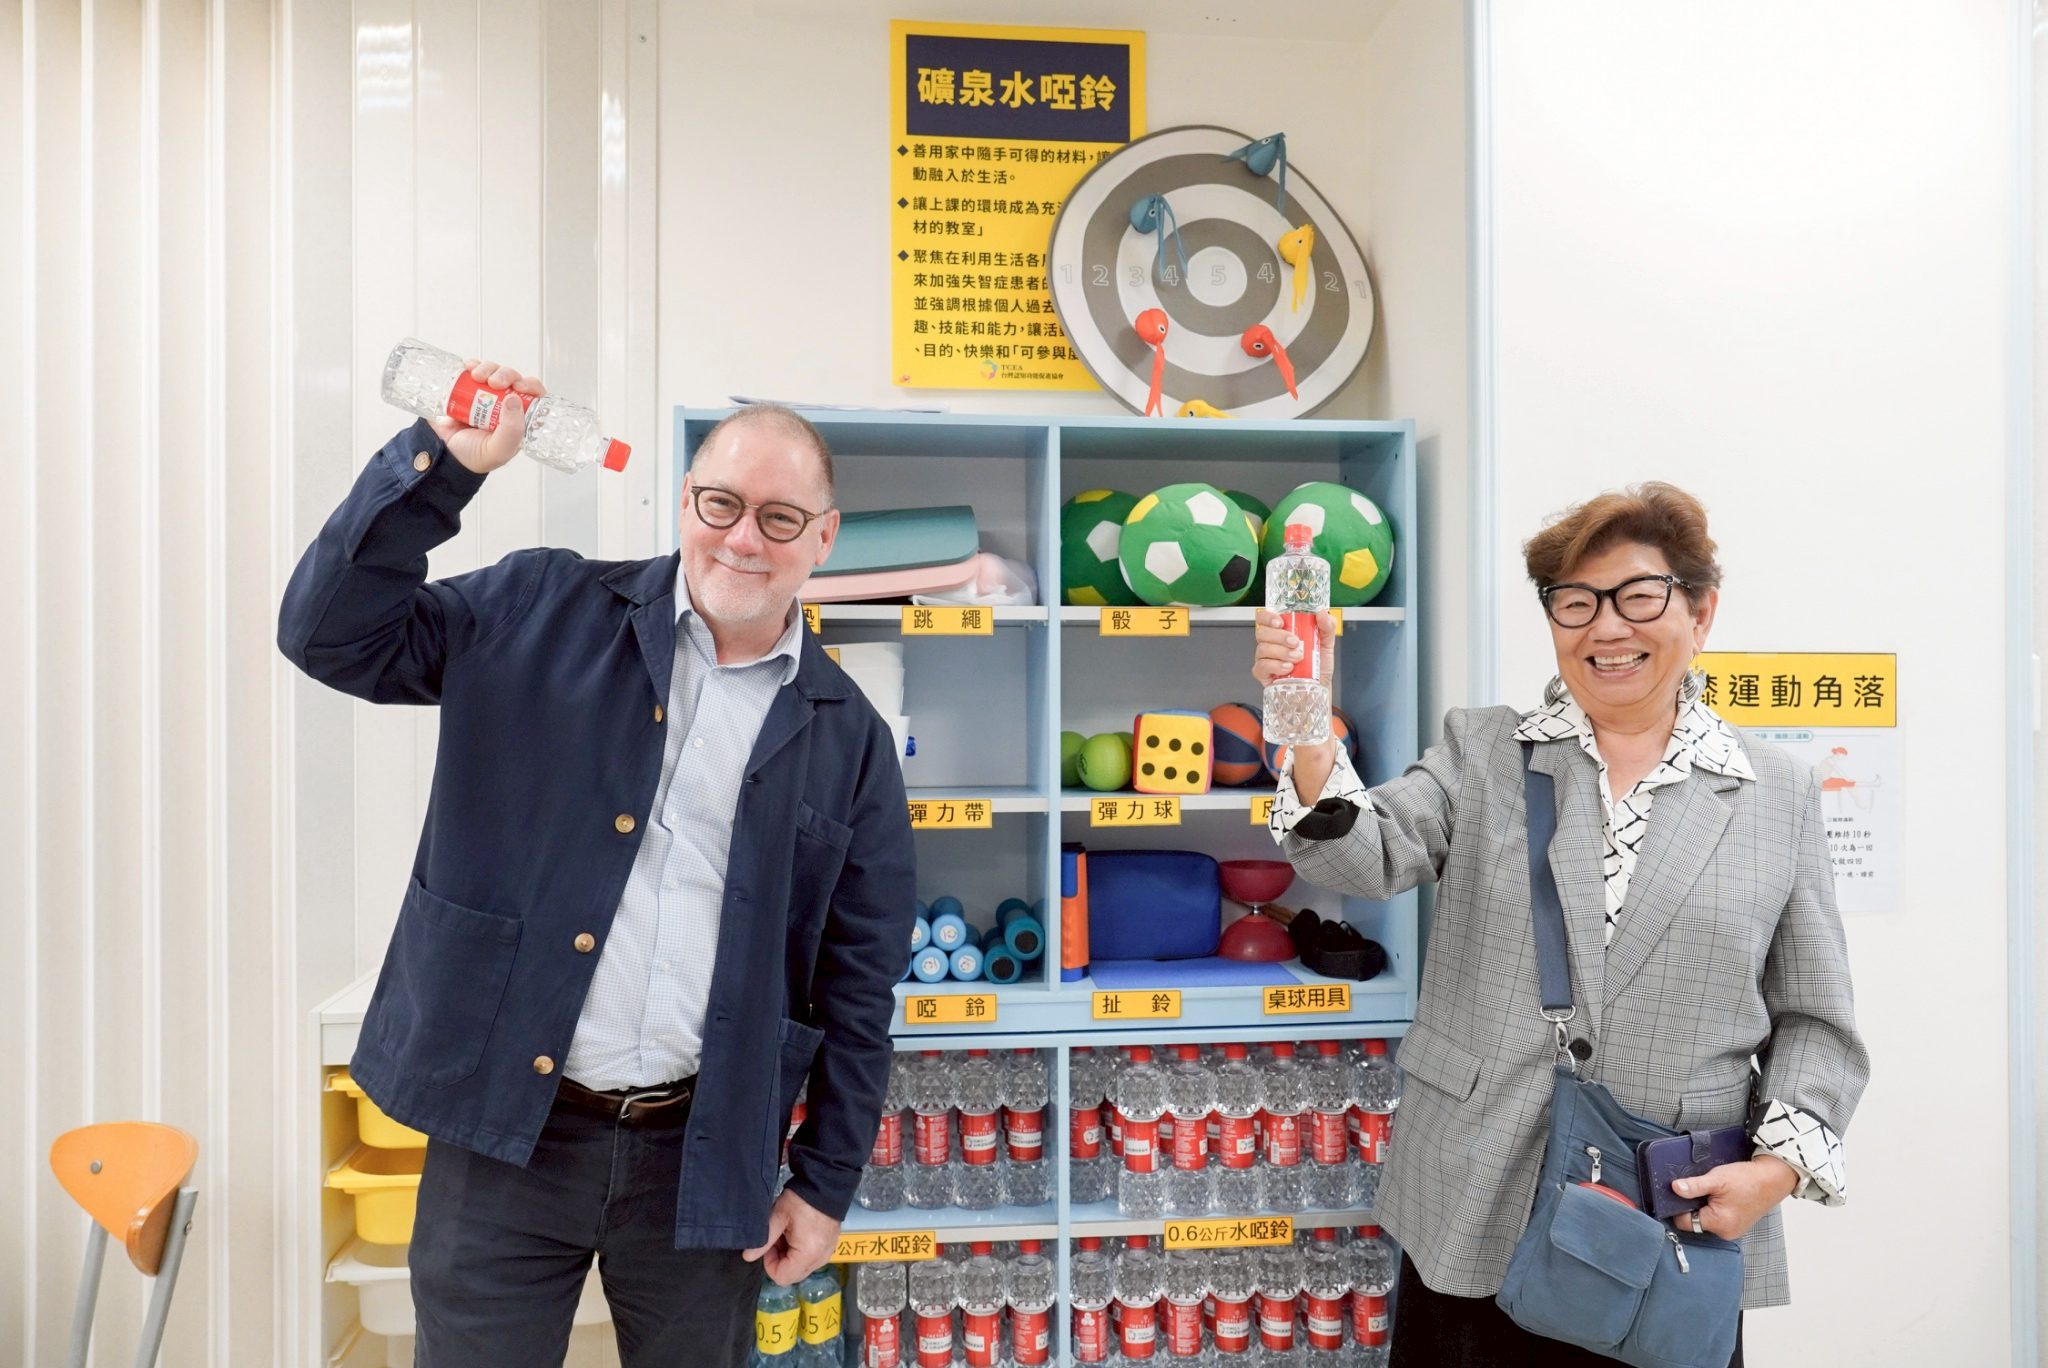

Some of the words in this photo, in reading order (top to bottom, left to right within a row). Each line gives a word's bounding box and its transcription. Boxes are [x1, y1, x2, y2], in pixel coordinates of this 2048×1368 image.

[917, 67, 1117, 111] 礦泉水啞鈴
[912, 166, 1016, 185] 動融入於生活。
[912, 196, 1062, 216] 讓上課的環境成為充
[912, 220, 983, 236] 材的教室」
[913, 249, 1046, 268] 聚焦在利用生活各
[1092, 265, 1109, 286] 2
[1129, 266, 1144, 288] 3
[1161, 265, 1179, 286] 4
[1210, 265, 1226, 286] 5
[1256, 263, 1274, 283] 4
[1323, 271, 1339, 292] 2
[914, 609, 981, 629] 跳繩
[1112, 610, 1178, 630] 骰子
[908, 802, 984, 823] 彈力帶
[1098, 799, 1174, 821] 彈力球
[917, 997, 985, 1018] 啞鈴
[1102, 993, 1171, 1015] 扯鈴
[1268, 988, 1346, 1009] 桌球用具
[834, 1234, 932, 1256] 公斤水啞鈴
